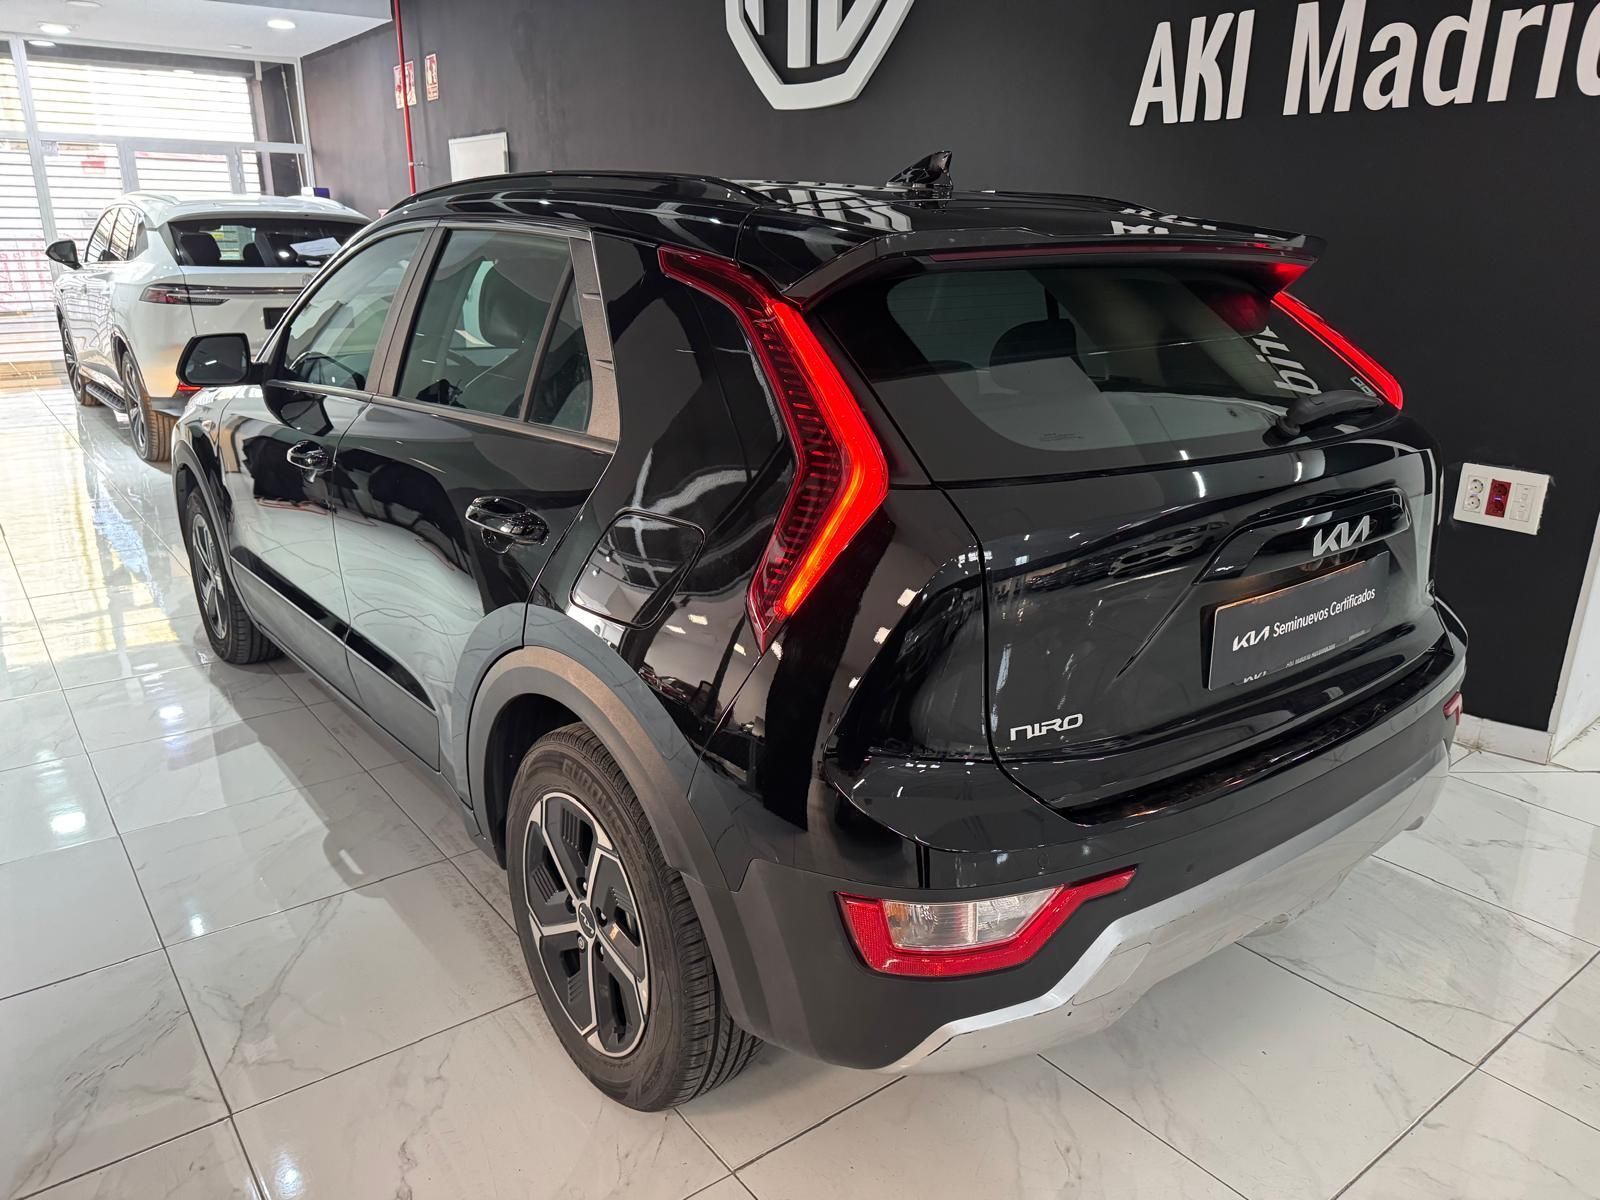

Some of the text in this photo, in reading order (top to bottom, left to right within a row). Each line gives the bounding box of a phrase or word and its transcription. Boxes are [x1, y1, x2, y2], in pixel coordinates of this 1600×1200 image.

[1130, 9, 1255, 126] AKI
[1313, 515, 1370, 557] KIA
[1232, 625, 1270, 652] KIA
[1273, 606, 1329, 638] Seminuevos
[1330, 587, 1376, 618] Certificados
[1010, 713, 1084, 742] NIRO
